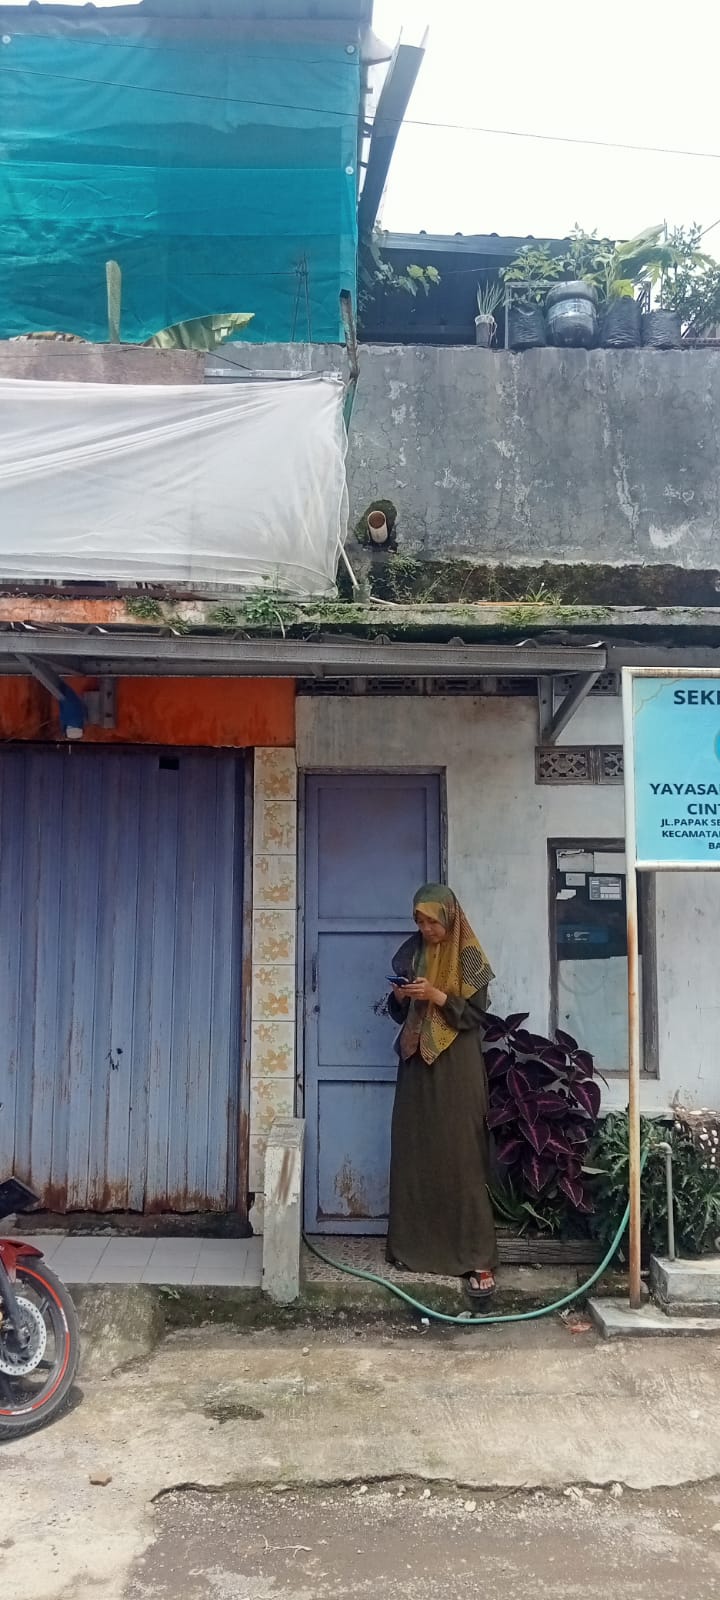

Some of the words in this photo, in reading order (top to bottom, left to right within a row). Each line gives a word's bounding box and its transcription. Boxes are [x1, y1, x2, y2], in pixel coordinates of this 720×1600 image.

[649, 783, 720, 795] YAYASA
[687, 803, 720, 815] CIN
[660, 818, 708, 828] JL.PAPAK
[662, 830, 720, 838] KECAMATA
